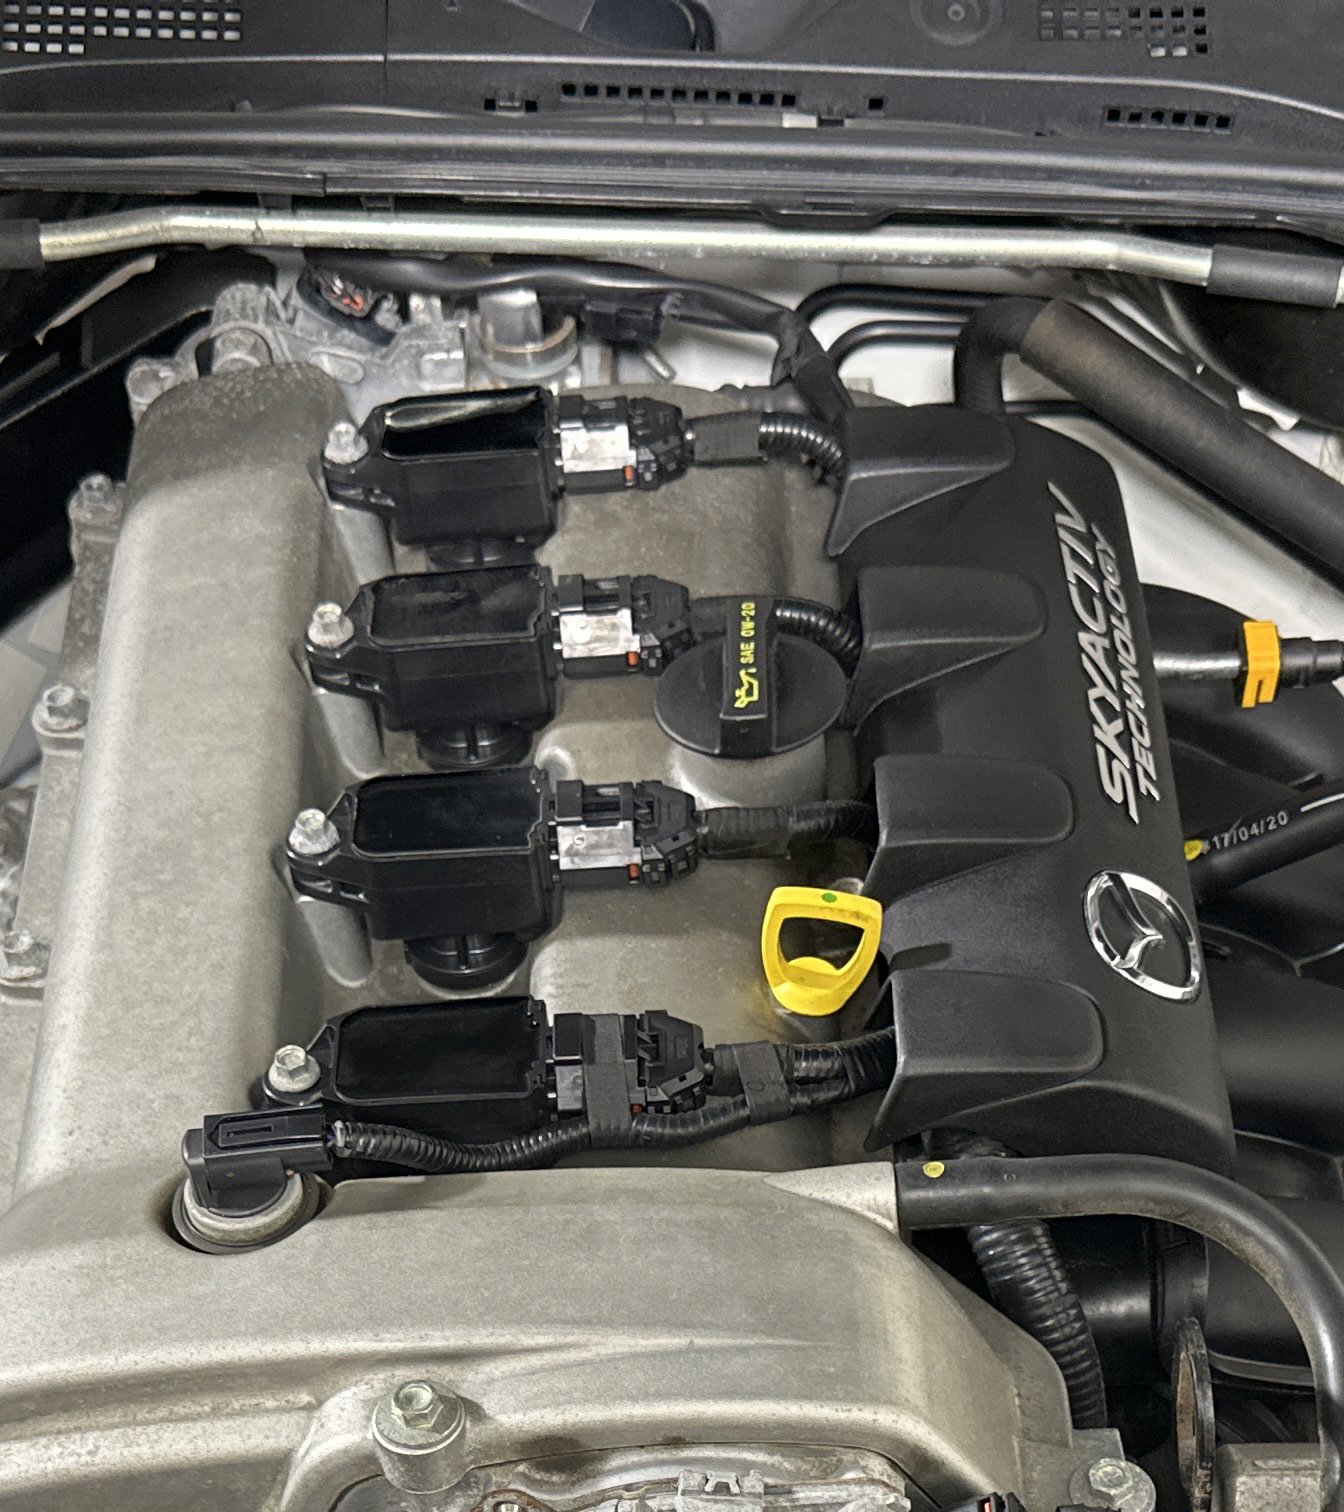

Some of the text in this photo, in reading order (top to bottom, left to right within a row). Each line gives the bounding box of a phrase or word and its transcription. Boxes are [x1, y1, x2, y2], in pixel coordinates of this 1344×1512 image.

[740, 602, 755, 663] SAE 0W-20
[1047, 481, 1139, 824] SKYACTIV
[1090, 522, 1160, 800] TECHNOLOGY
